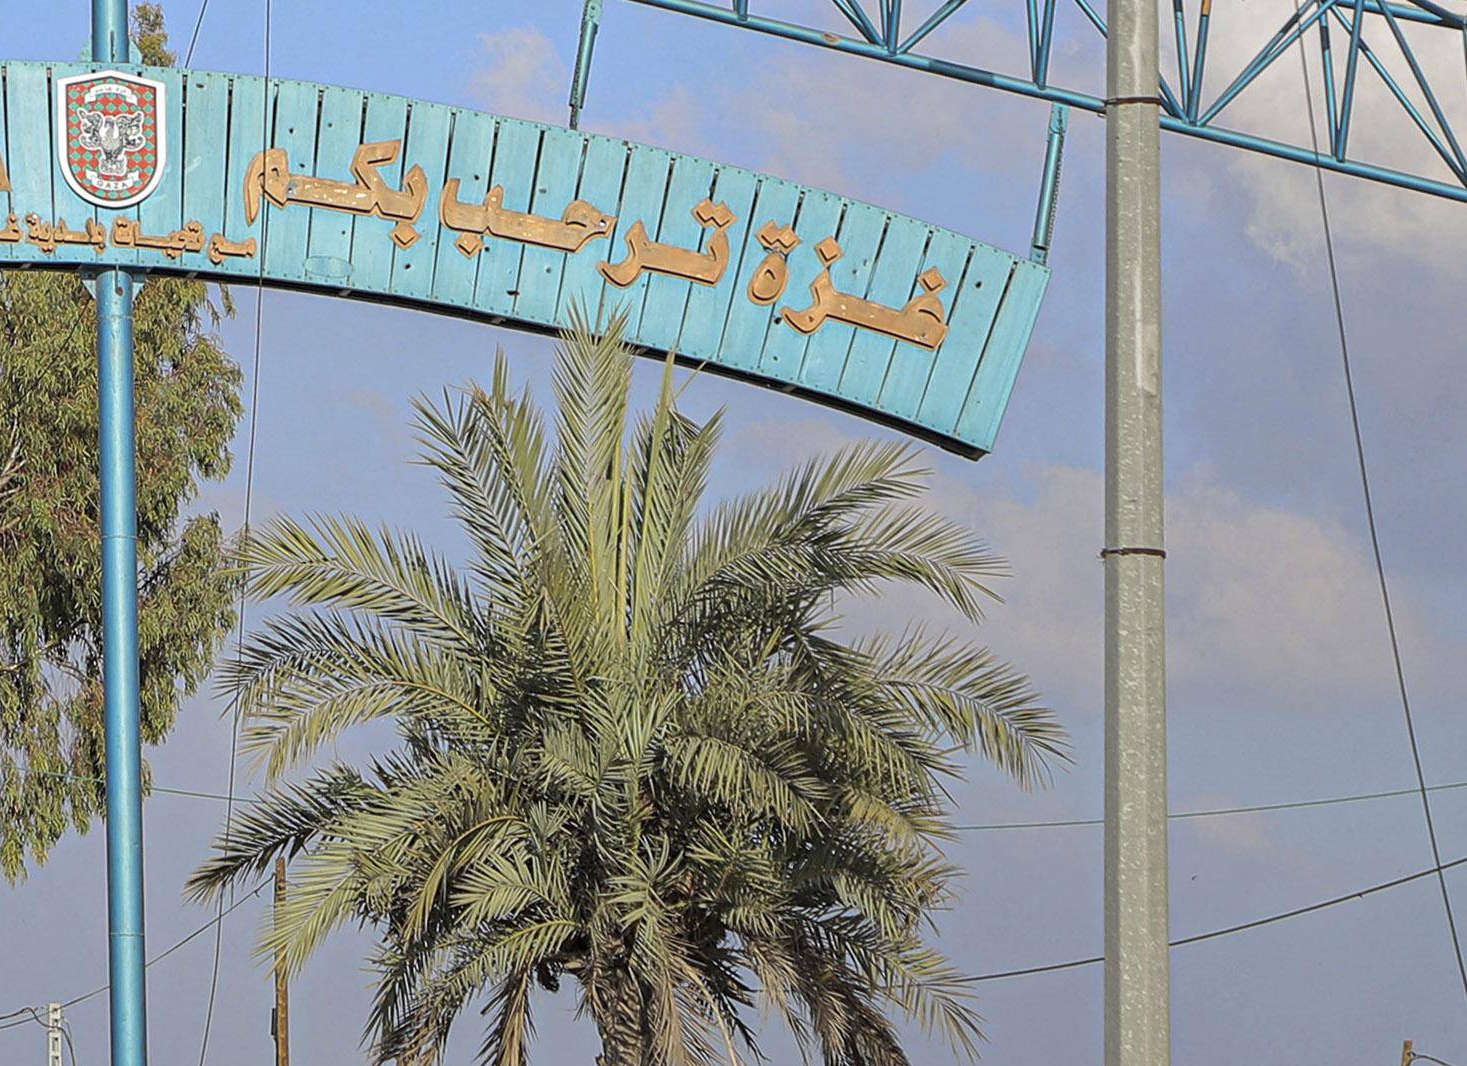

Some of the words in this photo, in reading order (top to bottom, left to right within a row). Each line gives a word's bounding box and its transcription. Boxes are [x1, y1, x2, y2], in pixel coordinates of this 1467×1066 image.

[24, 212, 106, 254] بلدية
[244, 138, 428, 250] بكم
[439, 177, 738, 289] ترحب
[112, 215, 205, 260] تحيات
[208, 231, 257, 264] مع
[747, 218, 949, 351] غزة
